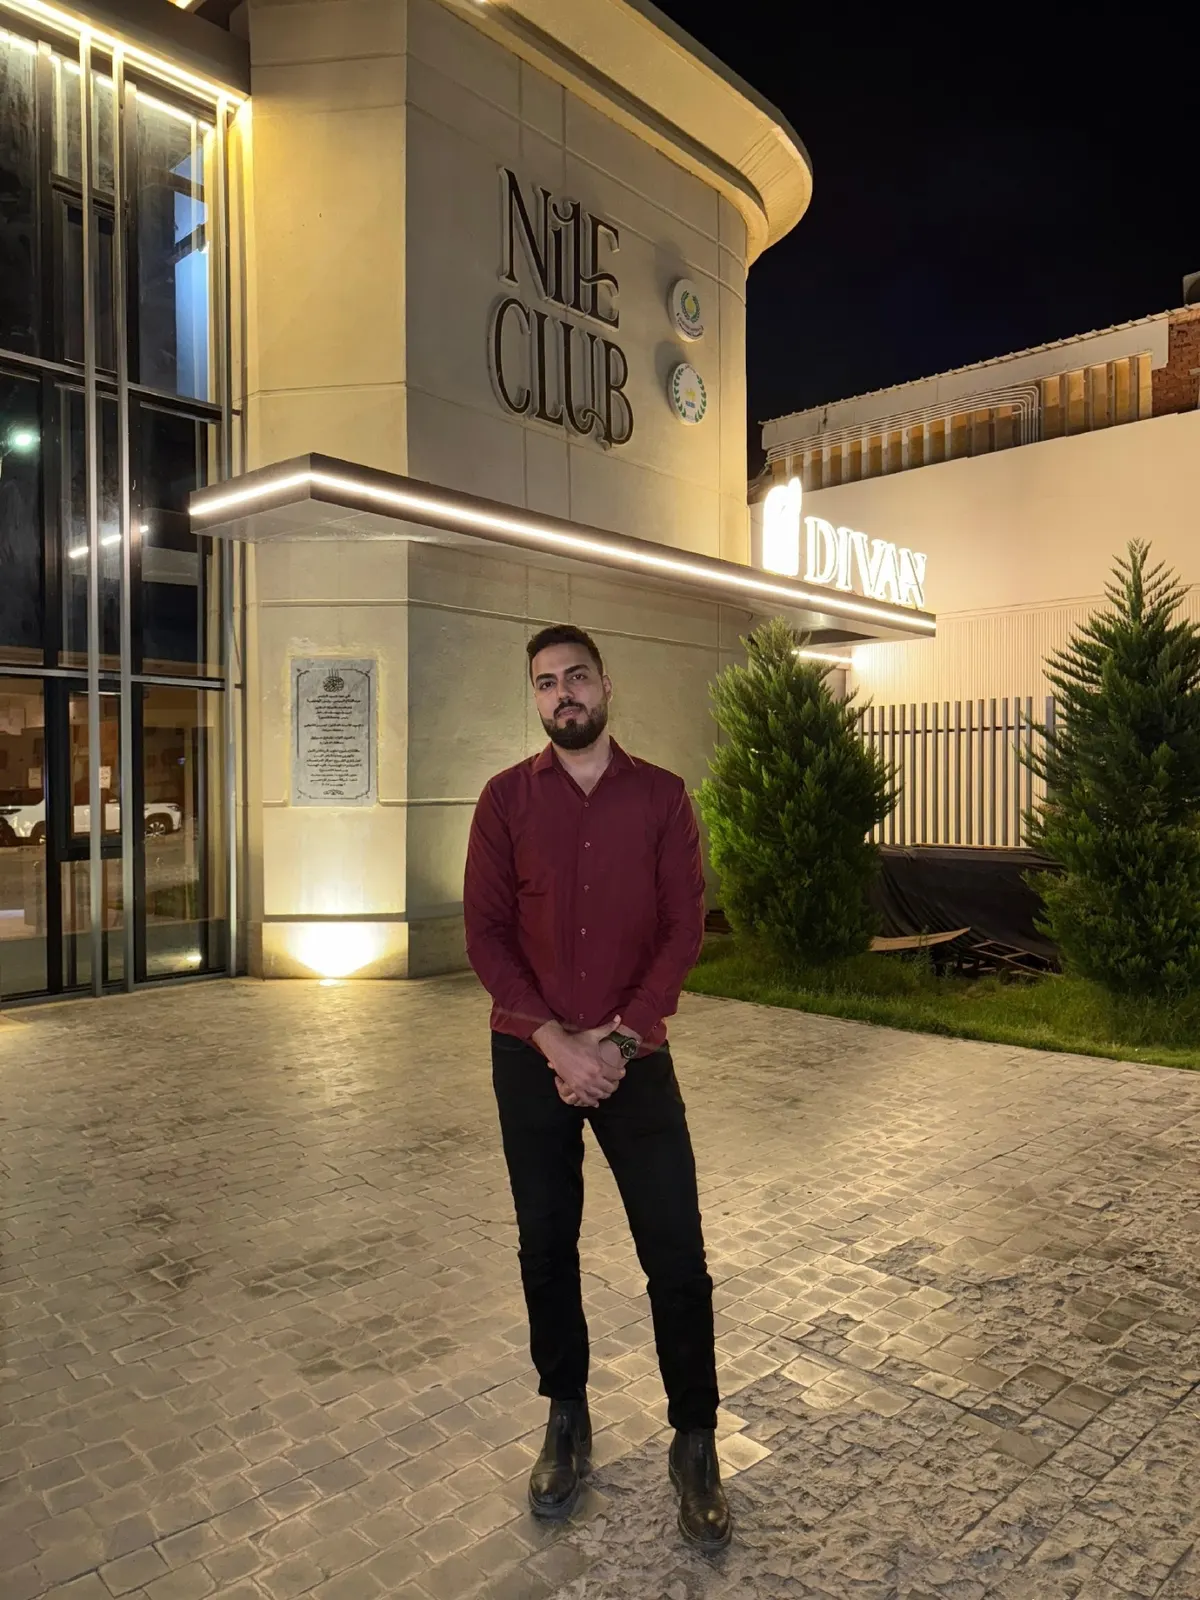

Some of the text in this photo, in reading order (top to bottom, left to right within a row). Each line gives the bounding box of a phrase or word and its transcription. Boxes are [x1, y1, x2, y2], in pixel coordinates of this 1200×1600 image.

[497, 167, 619, 331] NILE
[489, 298, 634, 450] CLUB
[804, 516, 927, 608] DIVAN
